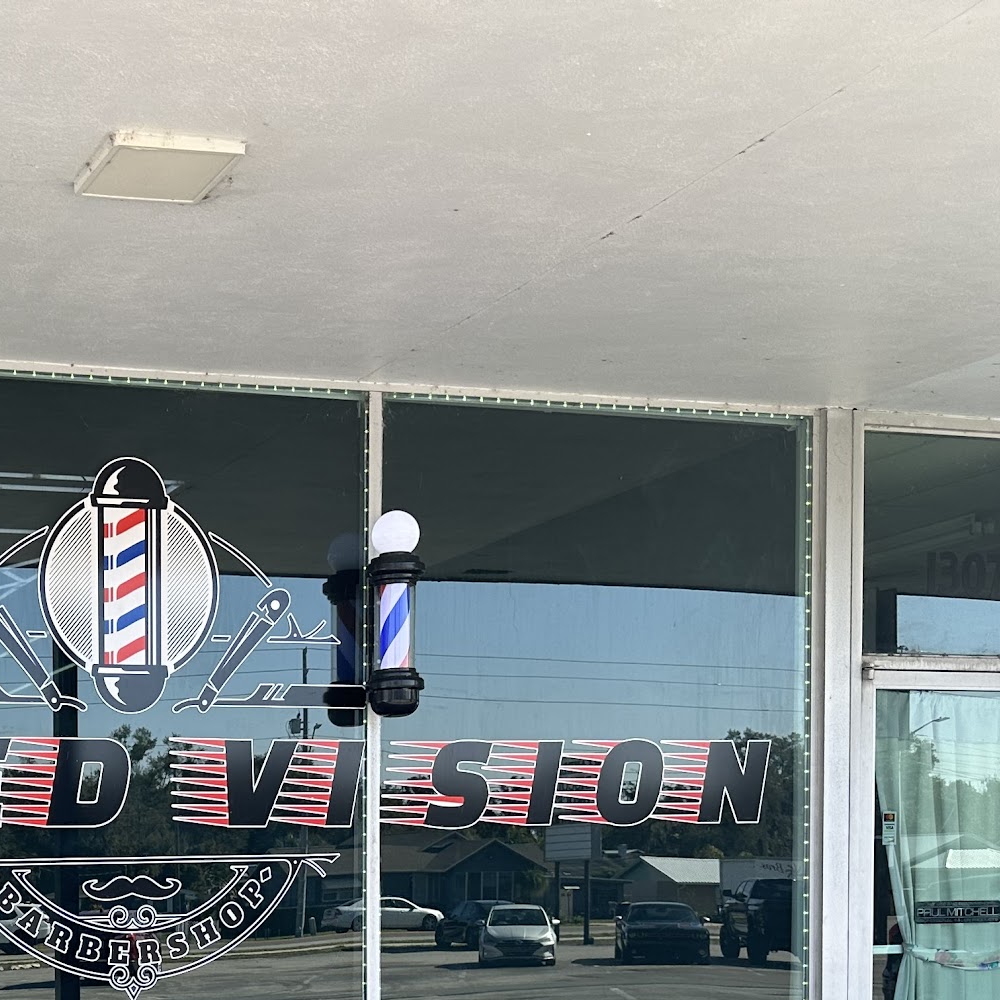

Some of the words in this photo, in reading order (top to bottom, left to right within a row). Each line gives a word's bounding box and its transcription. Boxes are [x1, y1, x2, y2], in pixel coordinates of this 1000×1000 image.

[169, 738, 772, 830] VISION
[916, 907, 946, 917] PAUL
[947, 905, 999, 917] MITCHELL
